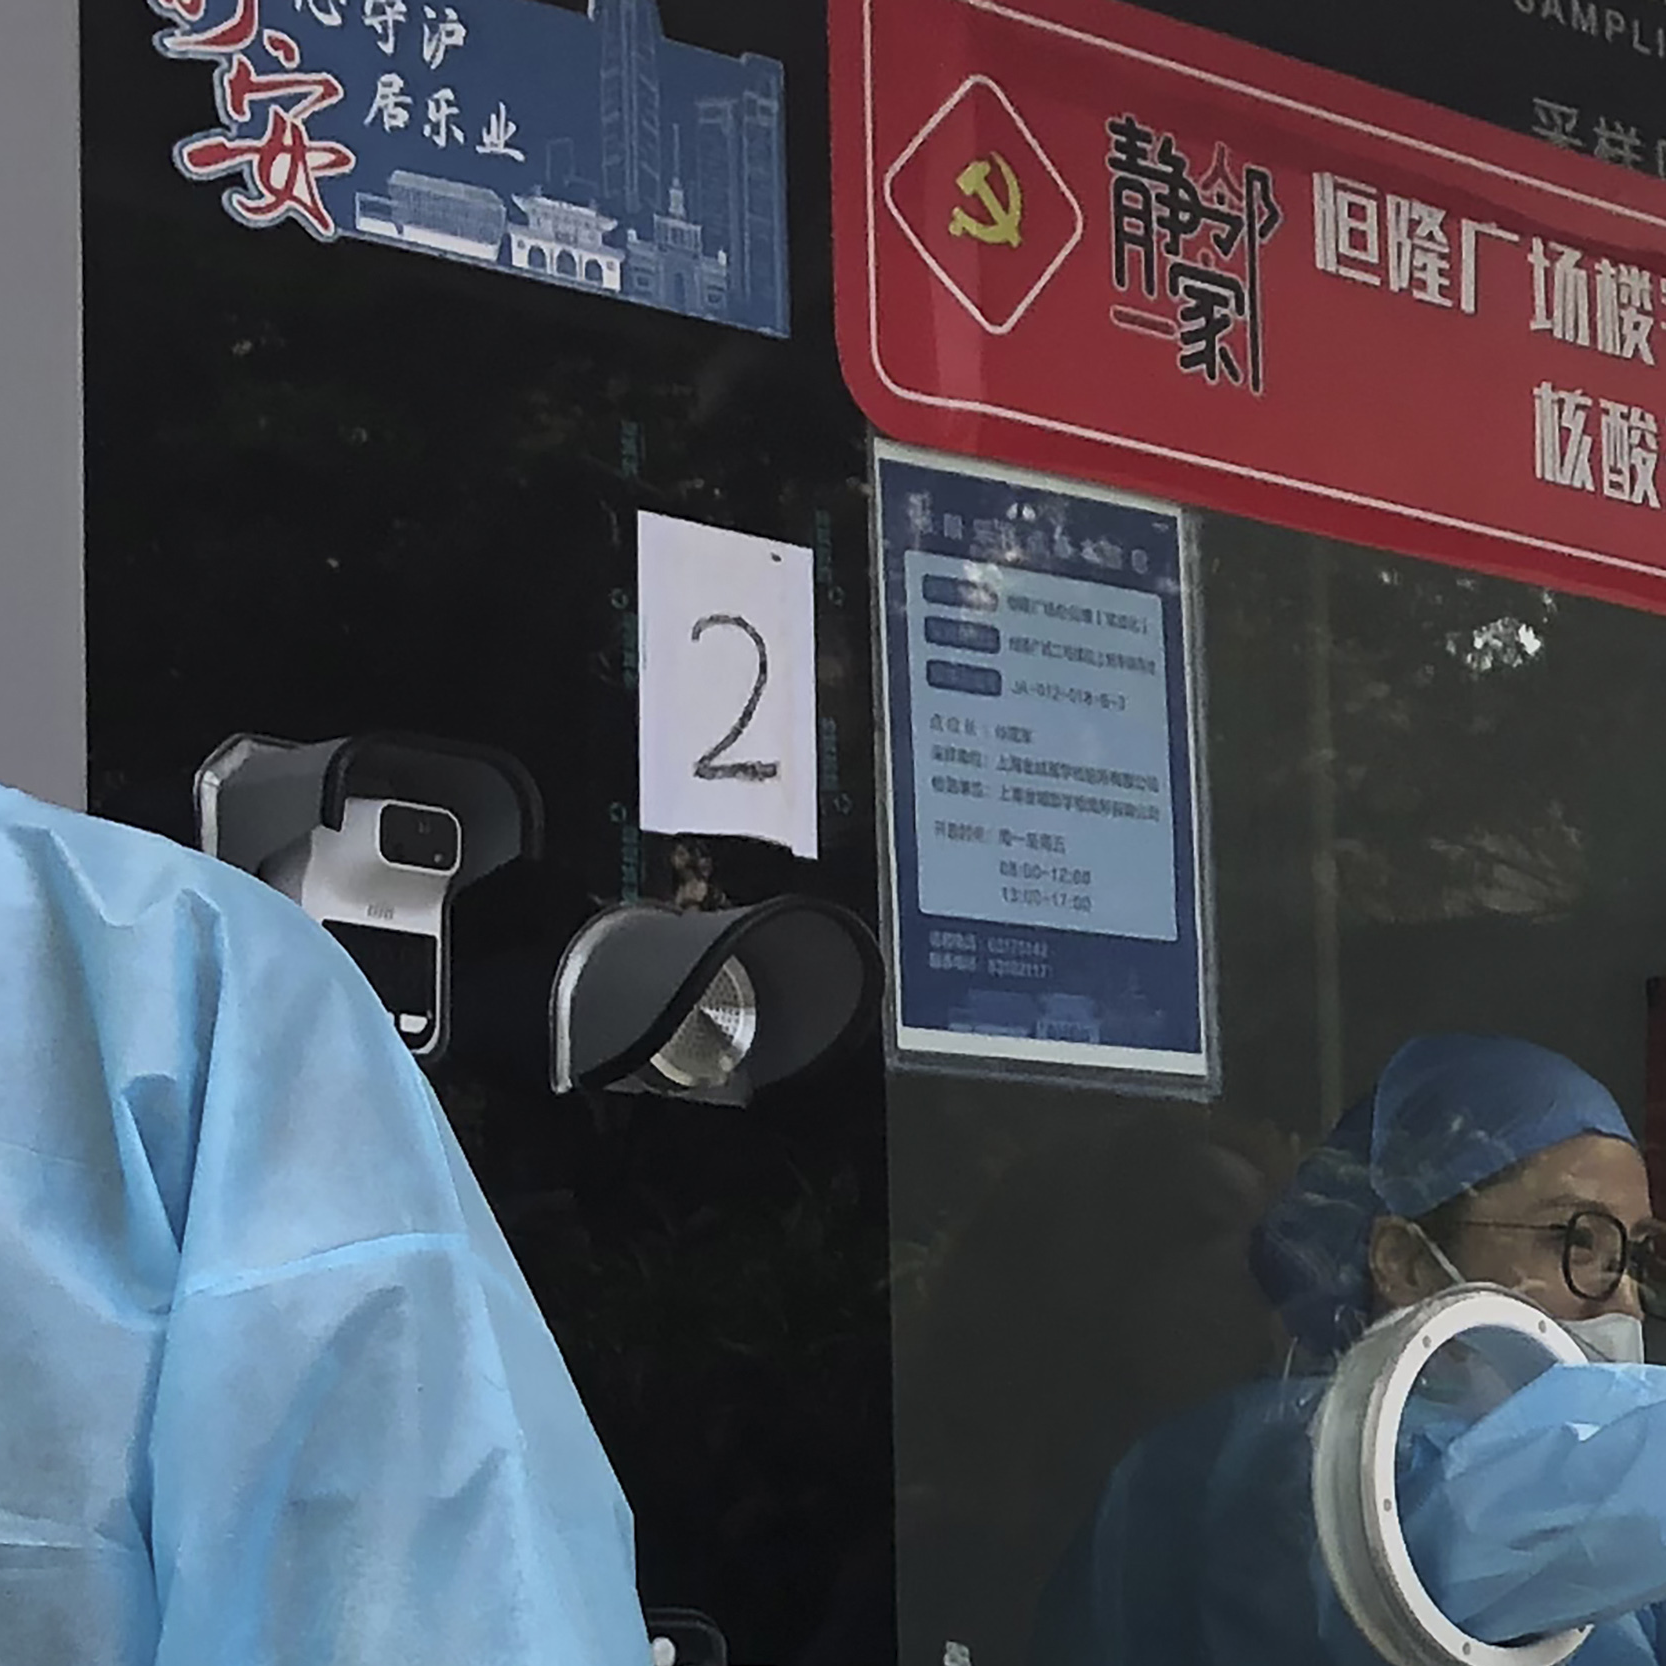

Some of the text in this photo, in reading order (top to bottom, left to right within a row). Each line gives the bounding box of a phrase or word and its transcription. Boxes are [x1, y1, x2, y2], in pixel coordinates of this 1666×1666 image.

[364, 72, 526, 162] 居乐业
[691, 613, 779, 782] 2
